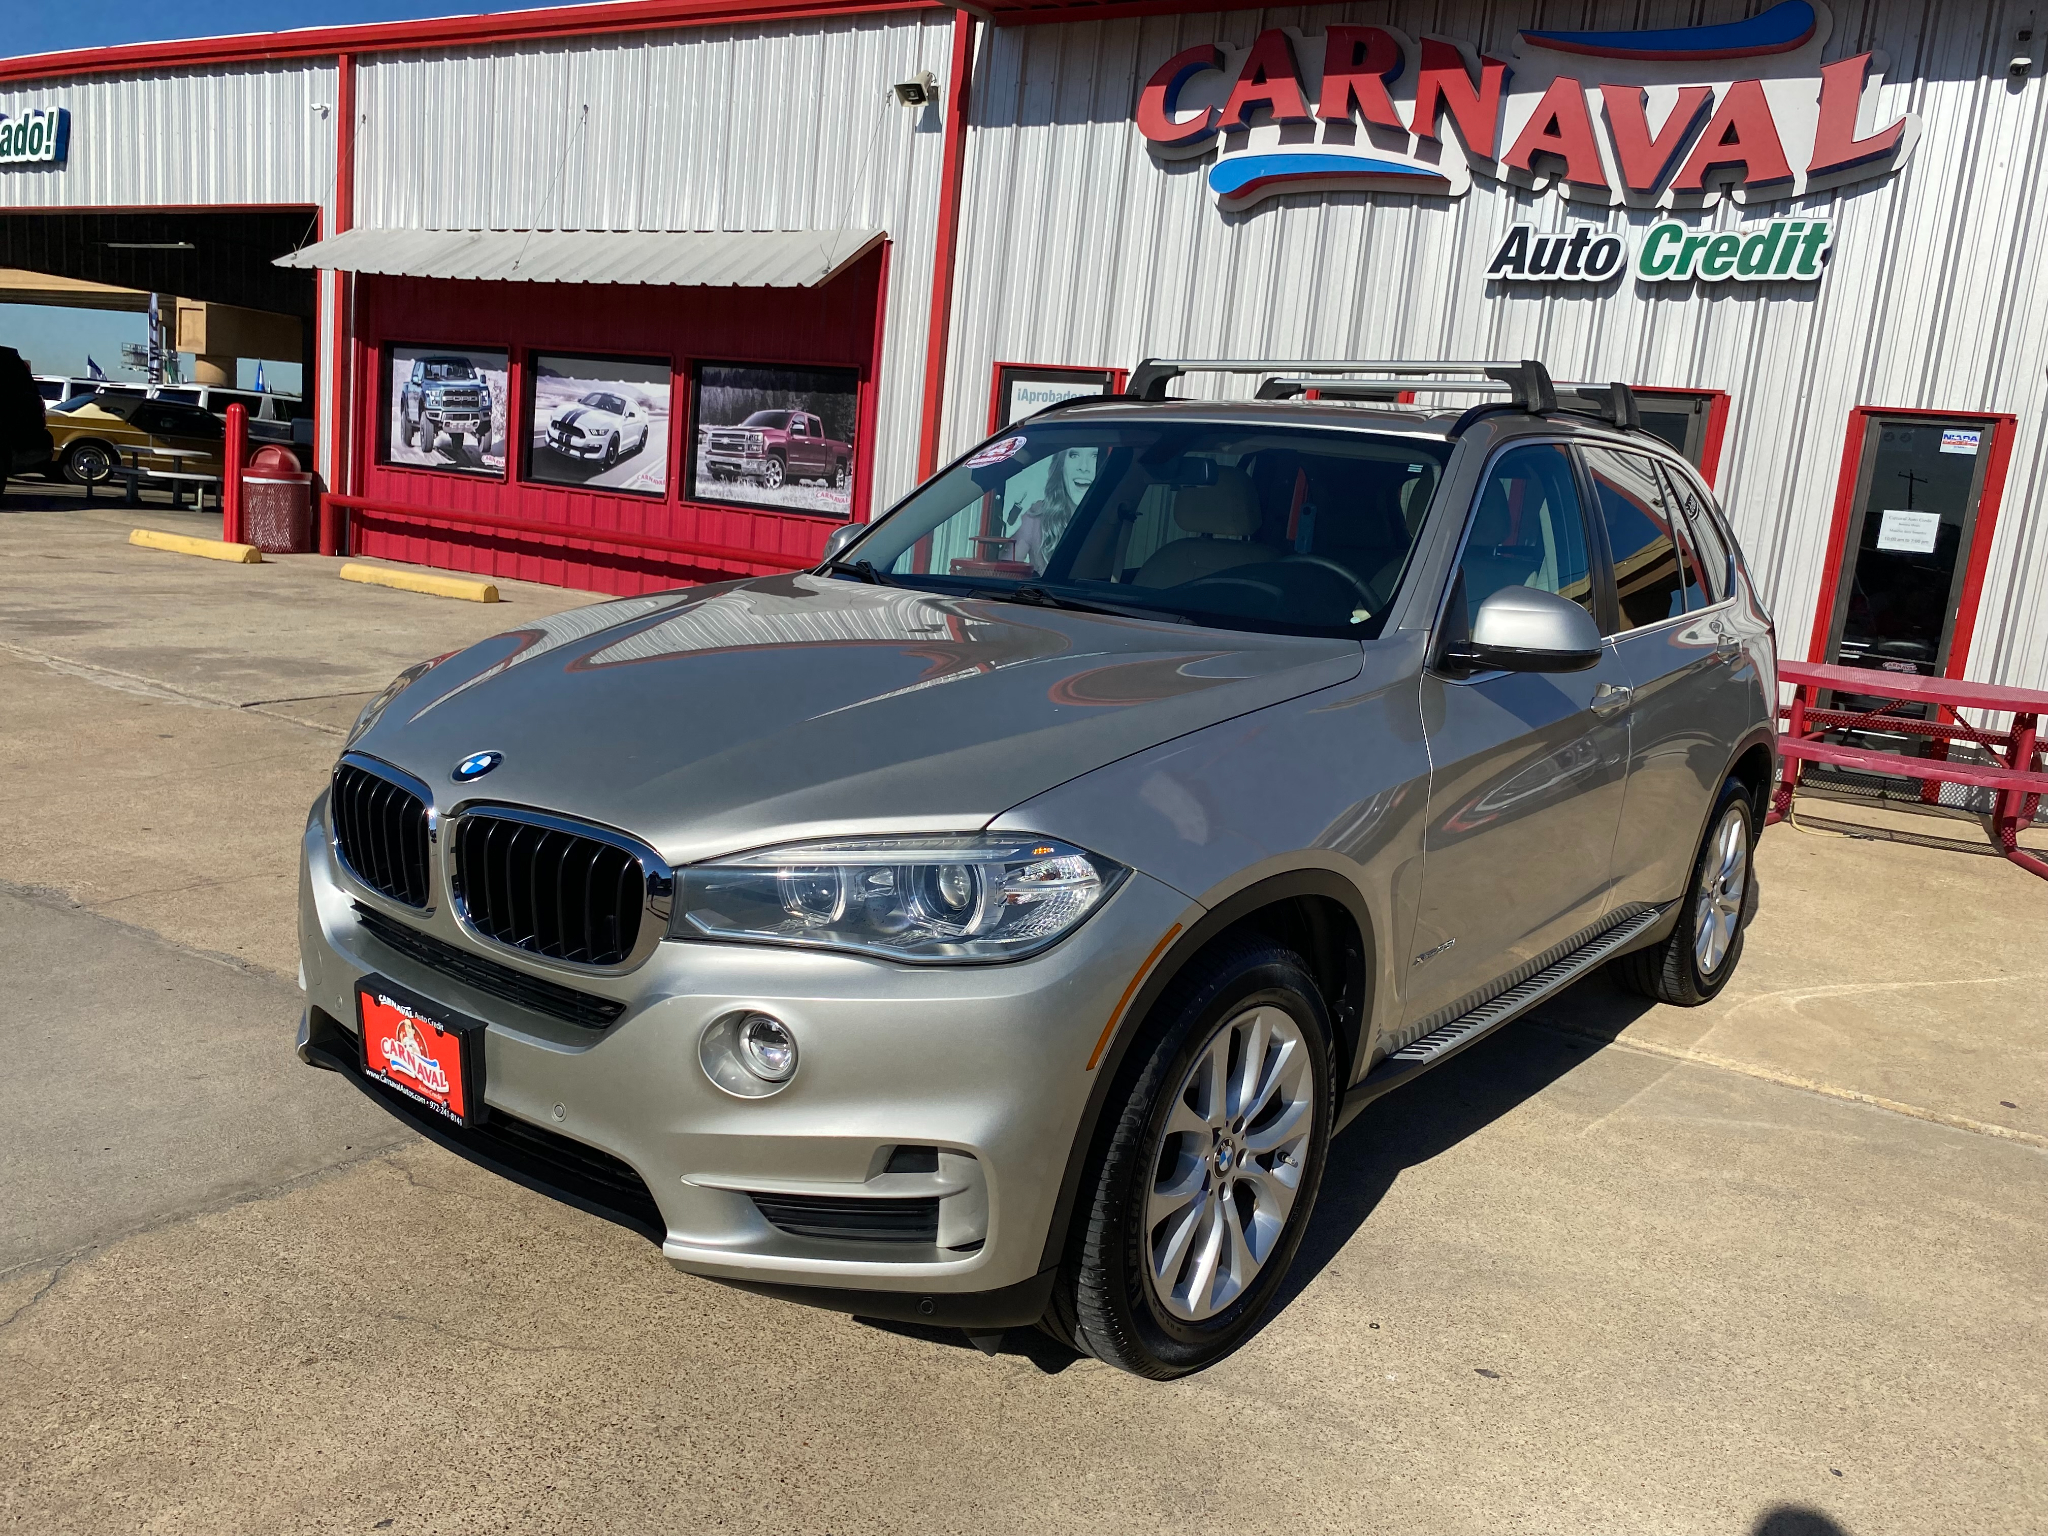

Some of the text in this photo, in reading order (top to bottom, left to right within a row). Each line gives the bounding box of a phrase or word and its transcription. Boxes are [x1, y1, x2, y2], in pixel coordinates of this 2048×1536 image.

[1137, 25, 1907, 192] CARNAVAL
[1486, 222, 1833, 277] Auto Credit
[379, 994, 444, 1032] CARNAVAL Auto Credit
[365, 1069, 425, 1104] www.CarnavalAutos.com
[381, 1038, 448, 1089] CARNAVAL
